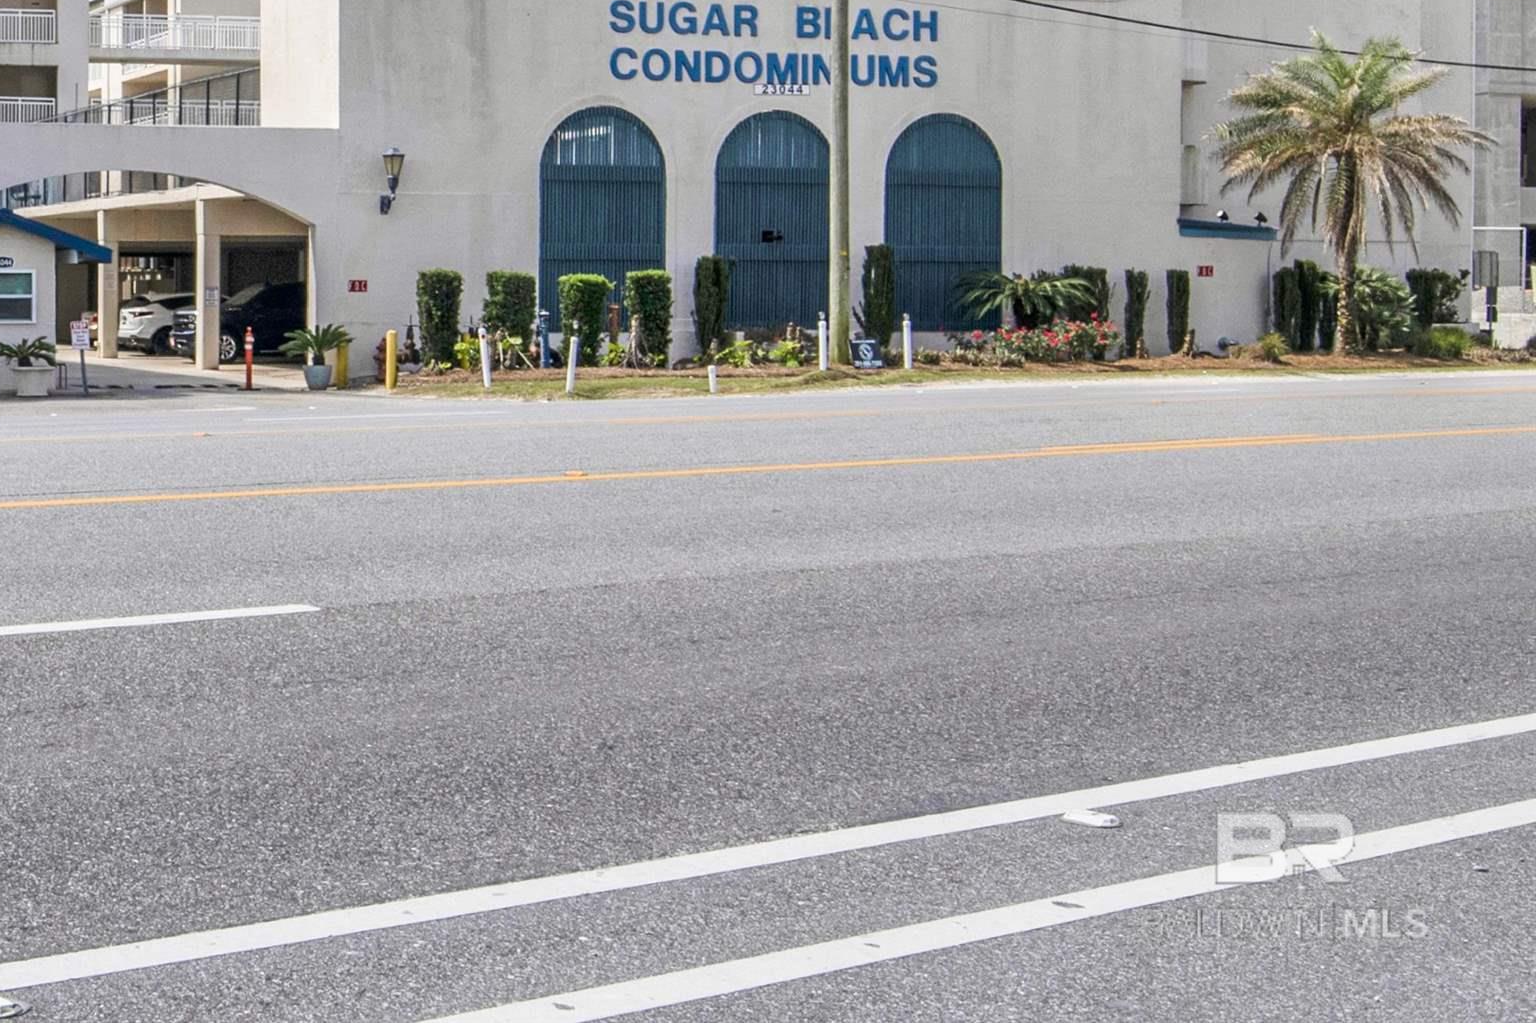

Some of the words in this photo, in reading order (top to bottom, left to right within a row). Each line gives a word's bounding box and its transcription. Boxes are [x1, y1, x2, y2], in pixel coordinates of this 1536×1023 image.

[608, 0, 760, 38] SUGAR
[608, 46, 939, 89] CONDOMINUMS
[762, 84, 804, 95] 23044
